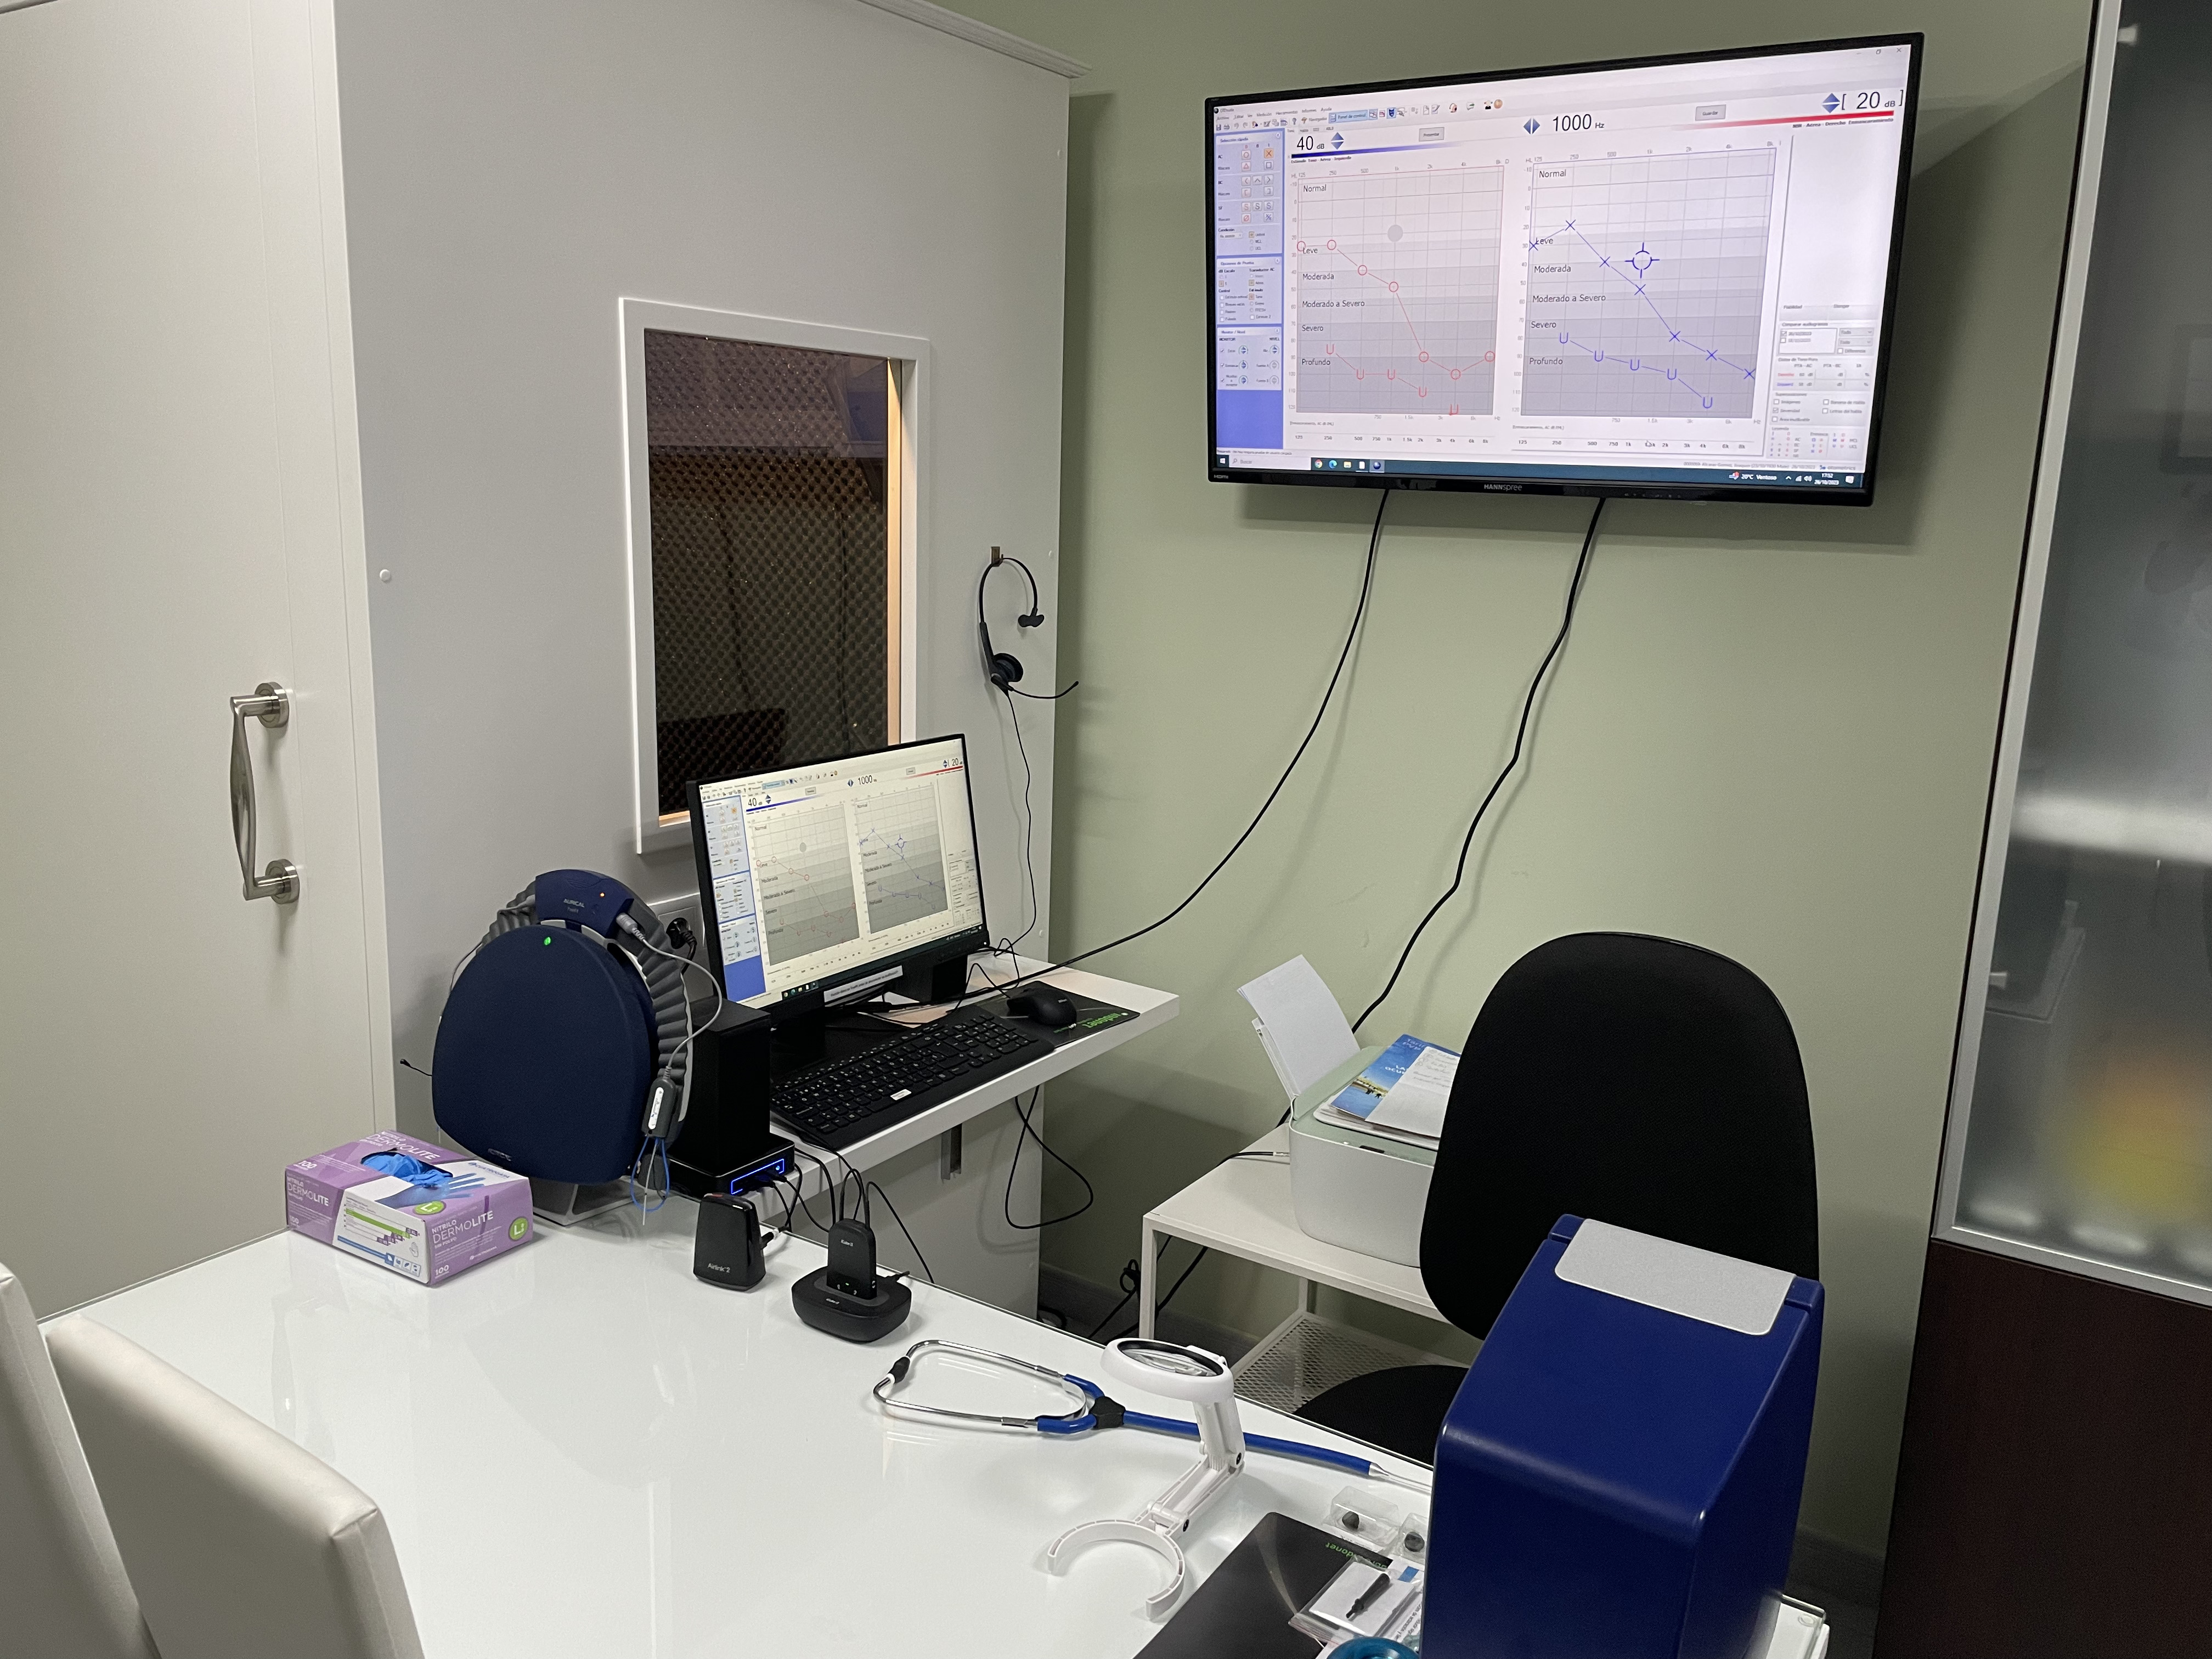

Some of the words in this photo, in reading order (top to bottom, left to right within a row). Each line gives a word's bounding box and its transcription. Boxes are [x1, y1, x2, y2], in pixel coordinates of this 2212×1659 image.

[1857, 91, 1880, 109] 20
[1553, 114, 1592, 132] 1000
[1296, 136, 1314, 150] 40
[1539, 169, 1566, 178] Normal
[1303, 184, 1327, 193] Normal
[1534, 264, 1571, 273] Moderada
[1532, 295, 1570, 303] Moderado
[1579, 294, 1606, 302] Severo
[1483, 483, 1522, 492] HANNspree
[952, 758, 959, 766] 20
[858, 775, 873, 786] 1000
[748, 797, 757, 807] 40
[563, 898, 585, 908] AURICAL
[365, 1133, 441, 1160] DERMOLITE
[298, 1160, 317, 1169] 100
[287, 1182, 329, 1206] DERMOLITE
[289, 1215, 300, 1224] 100
[432, 1219, 457, 1234] NITRILO
[433, 1210, 494, 1244] DERMOLITE
[435, 1265, 449, 1276] 100
